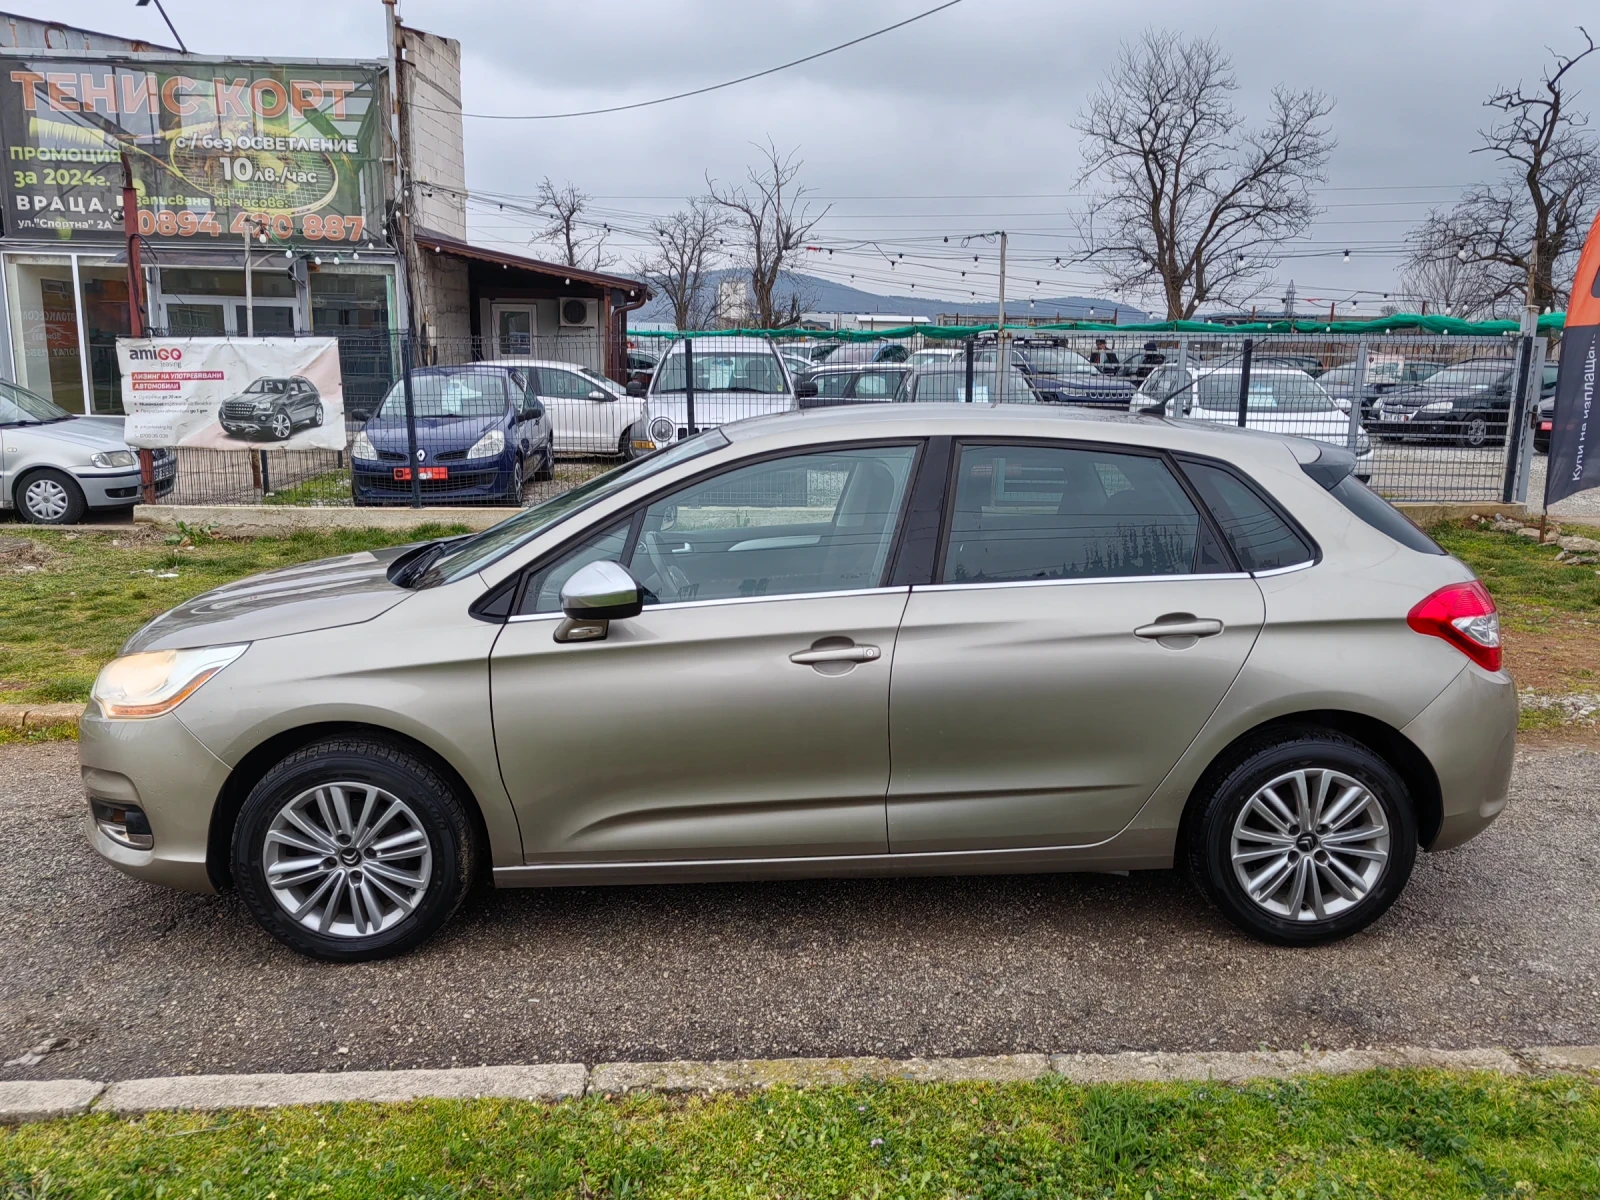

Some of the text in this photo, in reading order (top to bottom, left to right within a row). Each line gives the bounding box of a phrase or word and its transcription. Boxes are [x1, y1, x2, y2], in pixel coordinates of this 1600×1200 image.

[10, 70, 355, 120] ТЕНИС КОРТ
[202, 134, 233, 152] без
[237, 136, 359, 153] ОСВЕТЛЕНИЕ
[9, 146, 122, 164] ПРОМОЦИЯ
[43, 168, 111, 187] 2024г.
[16, 195, 112, 215] ВРАЦА,
[214, 197, 231, 208] на
[235, 196, 289, 209] часове:
[137, 209, 222, 237] 0894
[303, 214, 365, 241] 887
[160, 361, 182, 369] leasing
[135, 382, 179, 390] АВТОМОБИЛИ
[1572, 333, 1598, 481] Купи на изплаща
